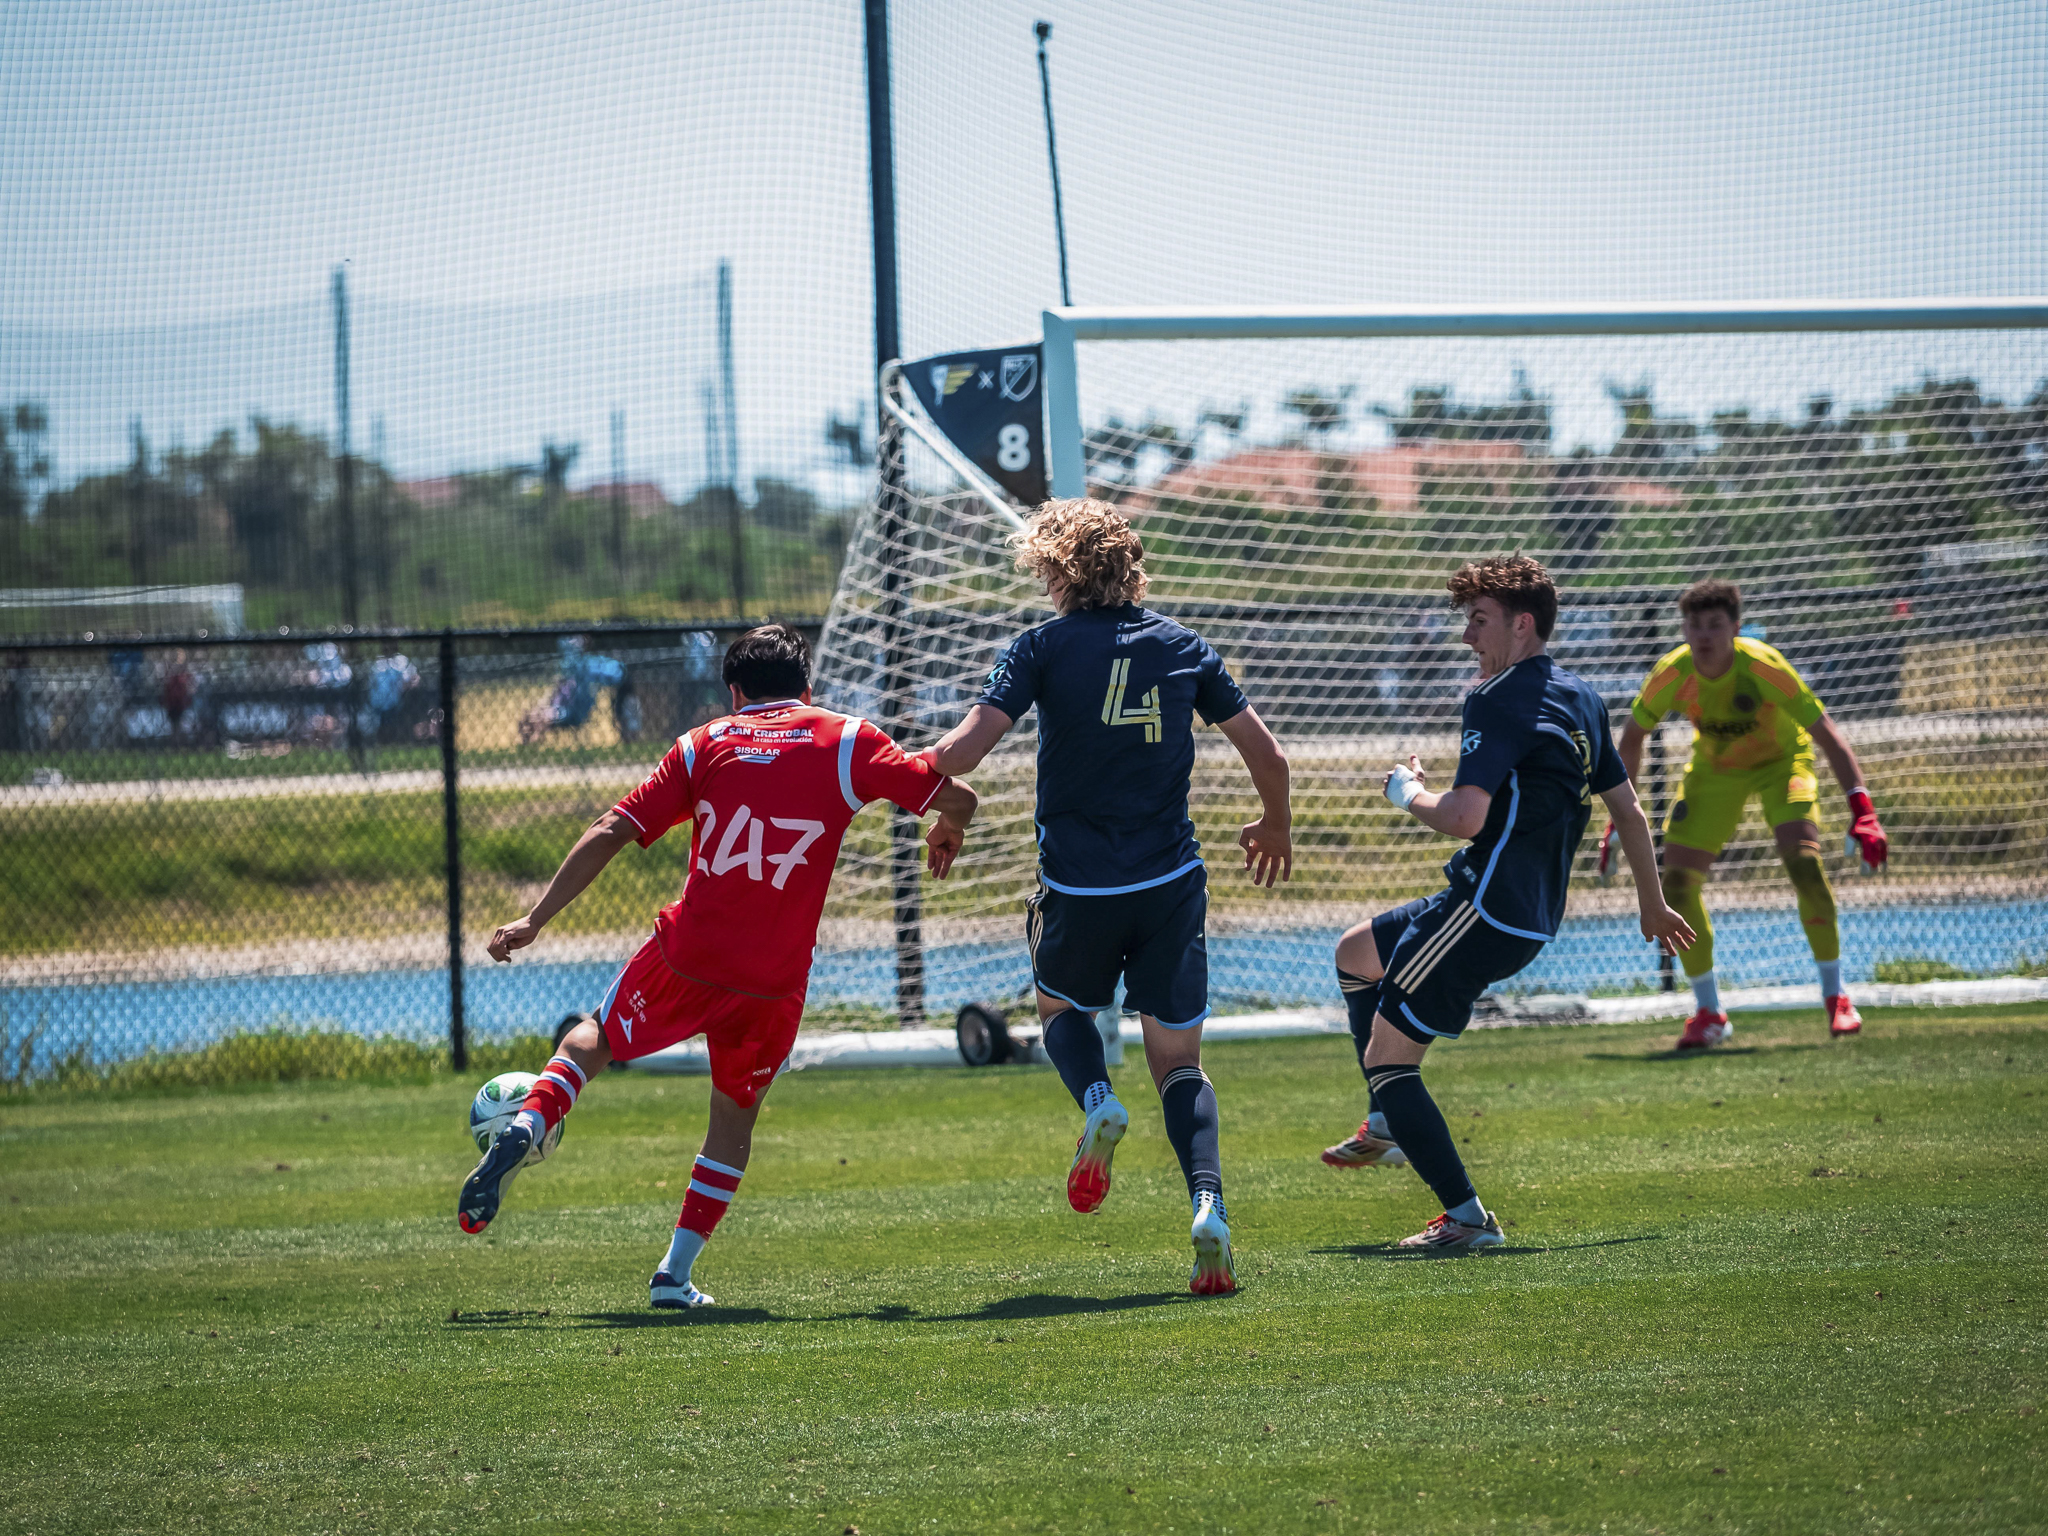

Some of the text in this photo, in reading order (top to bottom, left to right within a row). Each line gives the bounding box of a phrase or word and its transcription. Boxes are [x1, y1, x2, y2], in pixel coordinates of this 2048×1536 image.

[997, 423, 1031, 473] 8
[1101, 658, 1162, 743] 4
[728, 727, 751, 736] SAN
[735, 721, 757, 729] GRUPO
[734, 746, 781, 756] SISOLAR
[694, 799, 825, 890] 247
